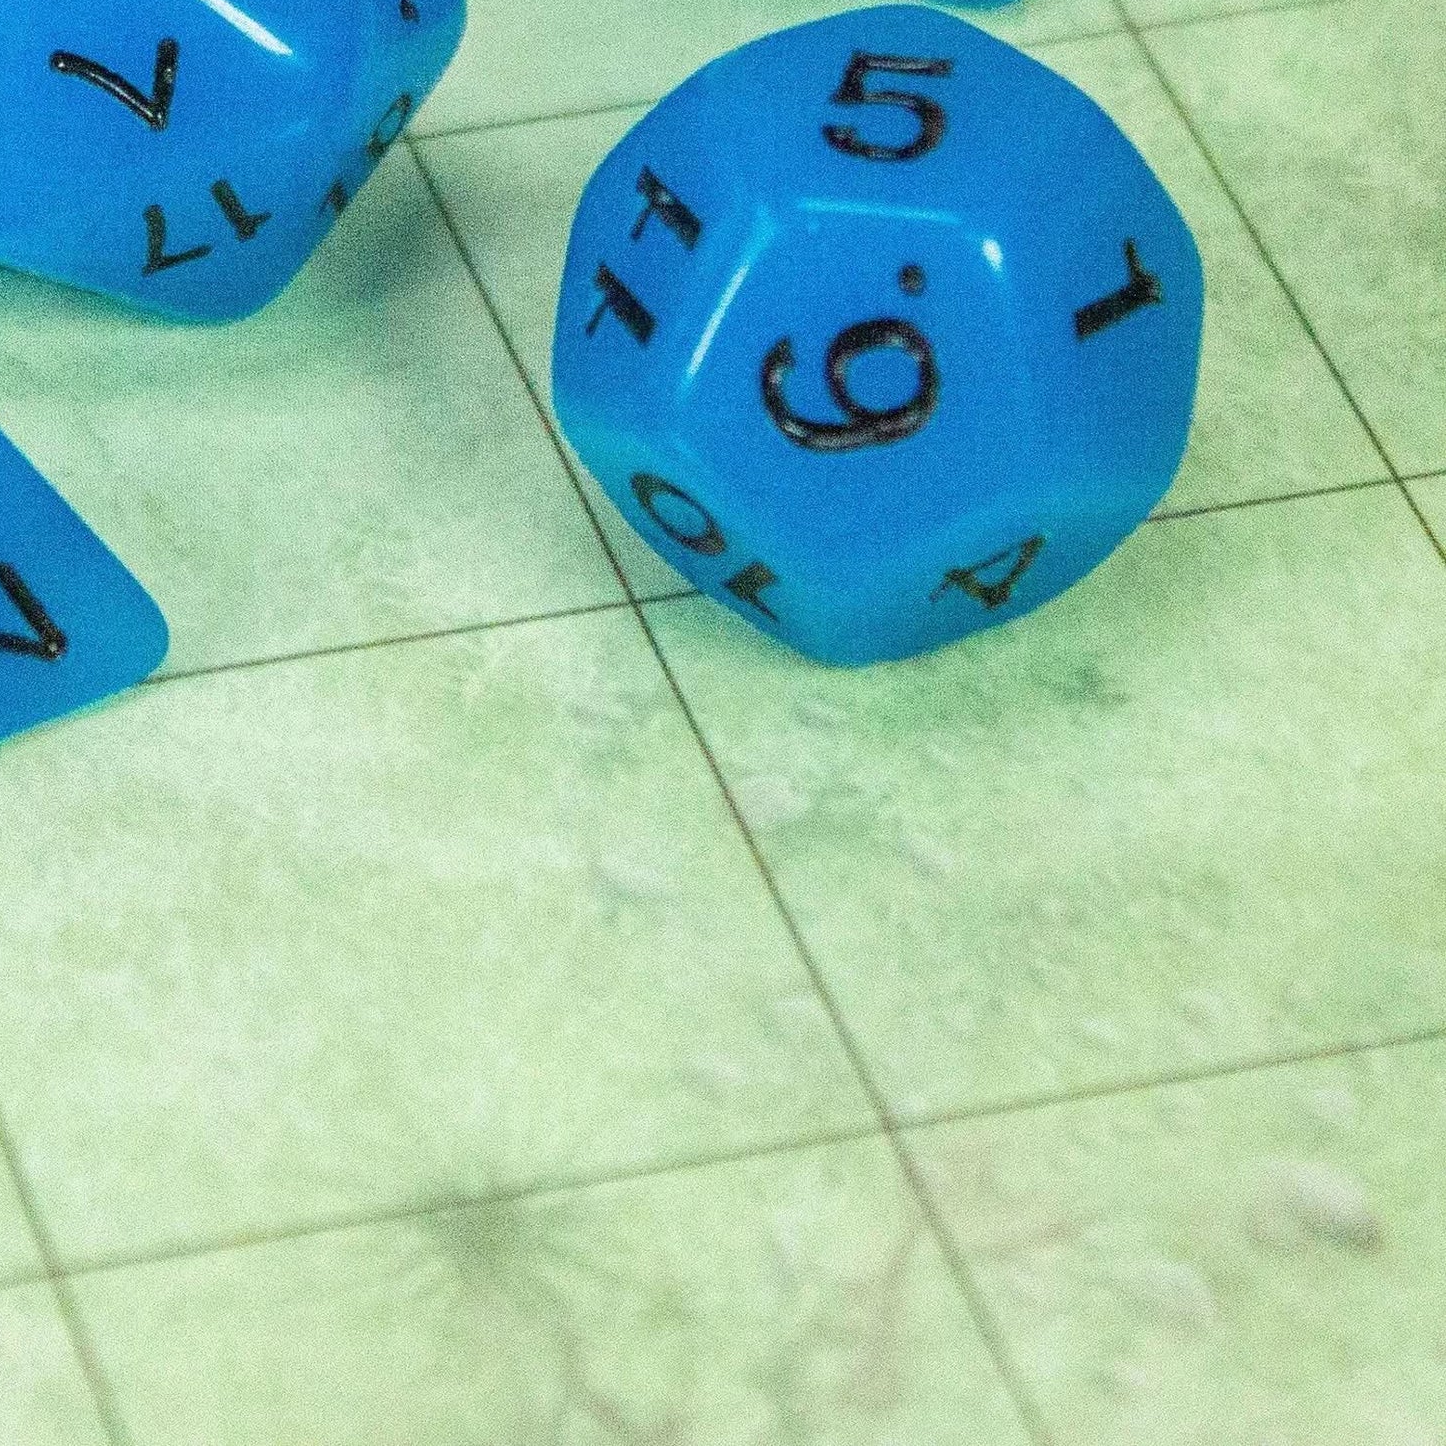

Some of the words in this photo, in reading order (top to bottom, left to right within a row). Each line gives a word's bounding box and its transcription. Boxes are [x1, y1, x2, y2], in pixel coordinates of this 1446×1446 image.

[50, 40, 178, 130] 7
[824, 53, 951, 160] 5
[143, 181, 269, 275] 17
[588, 170, 701, 343] 11
[1075, 241, 1161, 339] 1
[630, 471, 781, 626] 10
[929, 534, 1046, 610] 4
